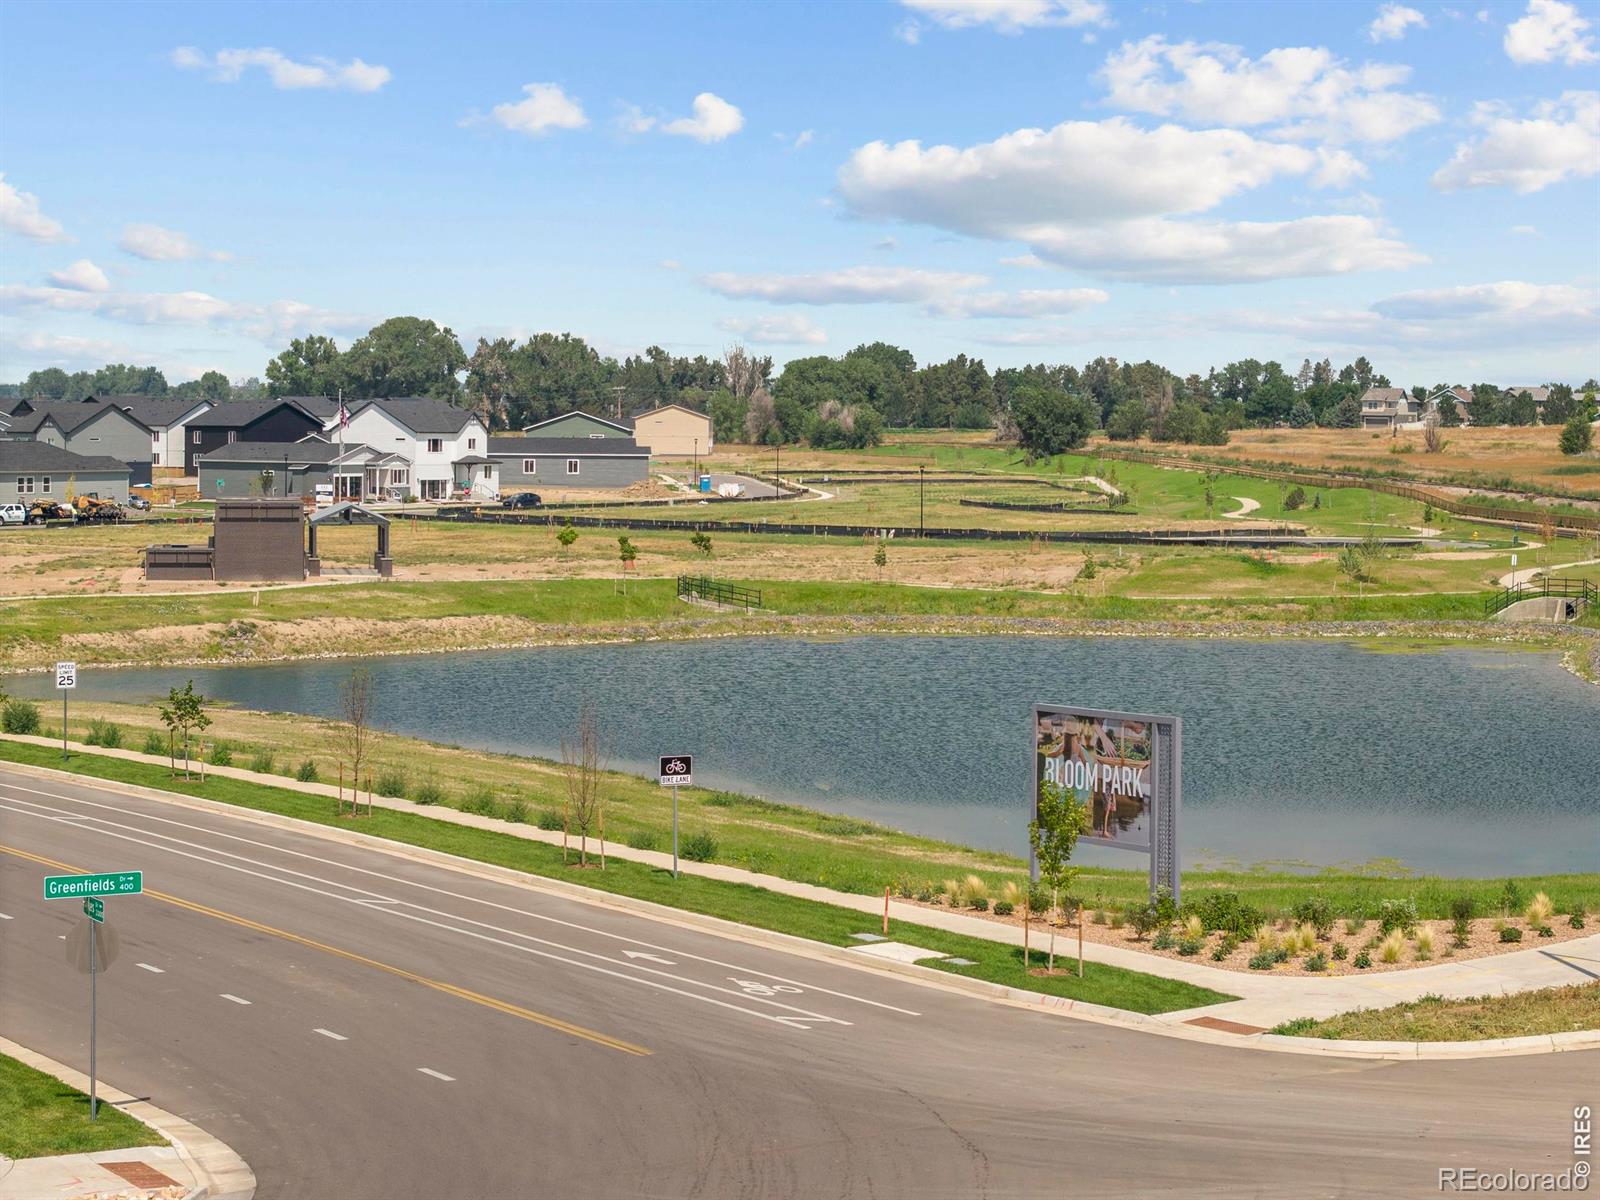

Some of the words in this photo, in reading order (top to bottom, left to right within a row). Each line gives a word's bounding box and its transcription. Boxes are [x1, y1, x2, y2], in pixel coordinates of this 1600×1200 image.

[58, 675, 74, 686] 25
[662, 776, 674, 784] BIKE
[675, 775, 690, 783] LANE
[1045, 757, 1098, 793] BLOOM
[1102, 763, 1144, 798] PARK
[49, 879, 115, 895] Greenfields
[119, 882, 134, 891] 400
